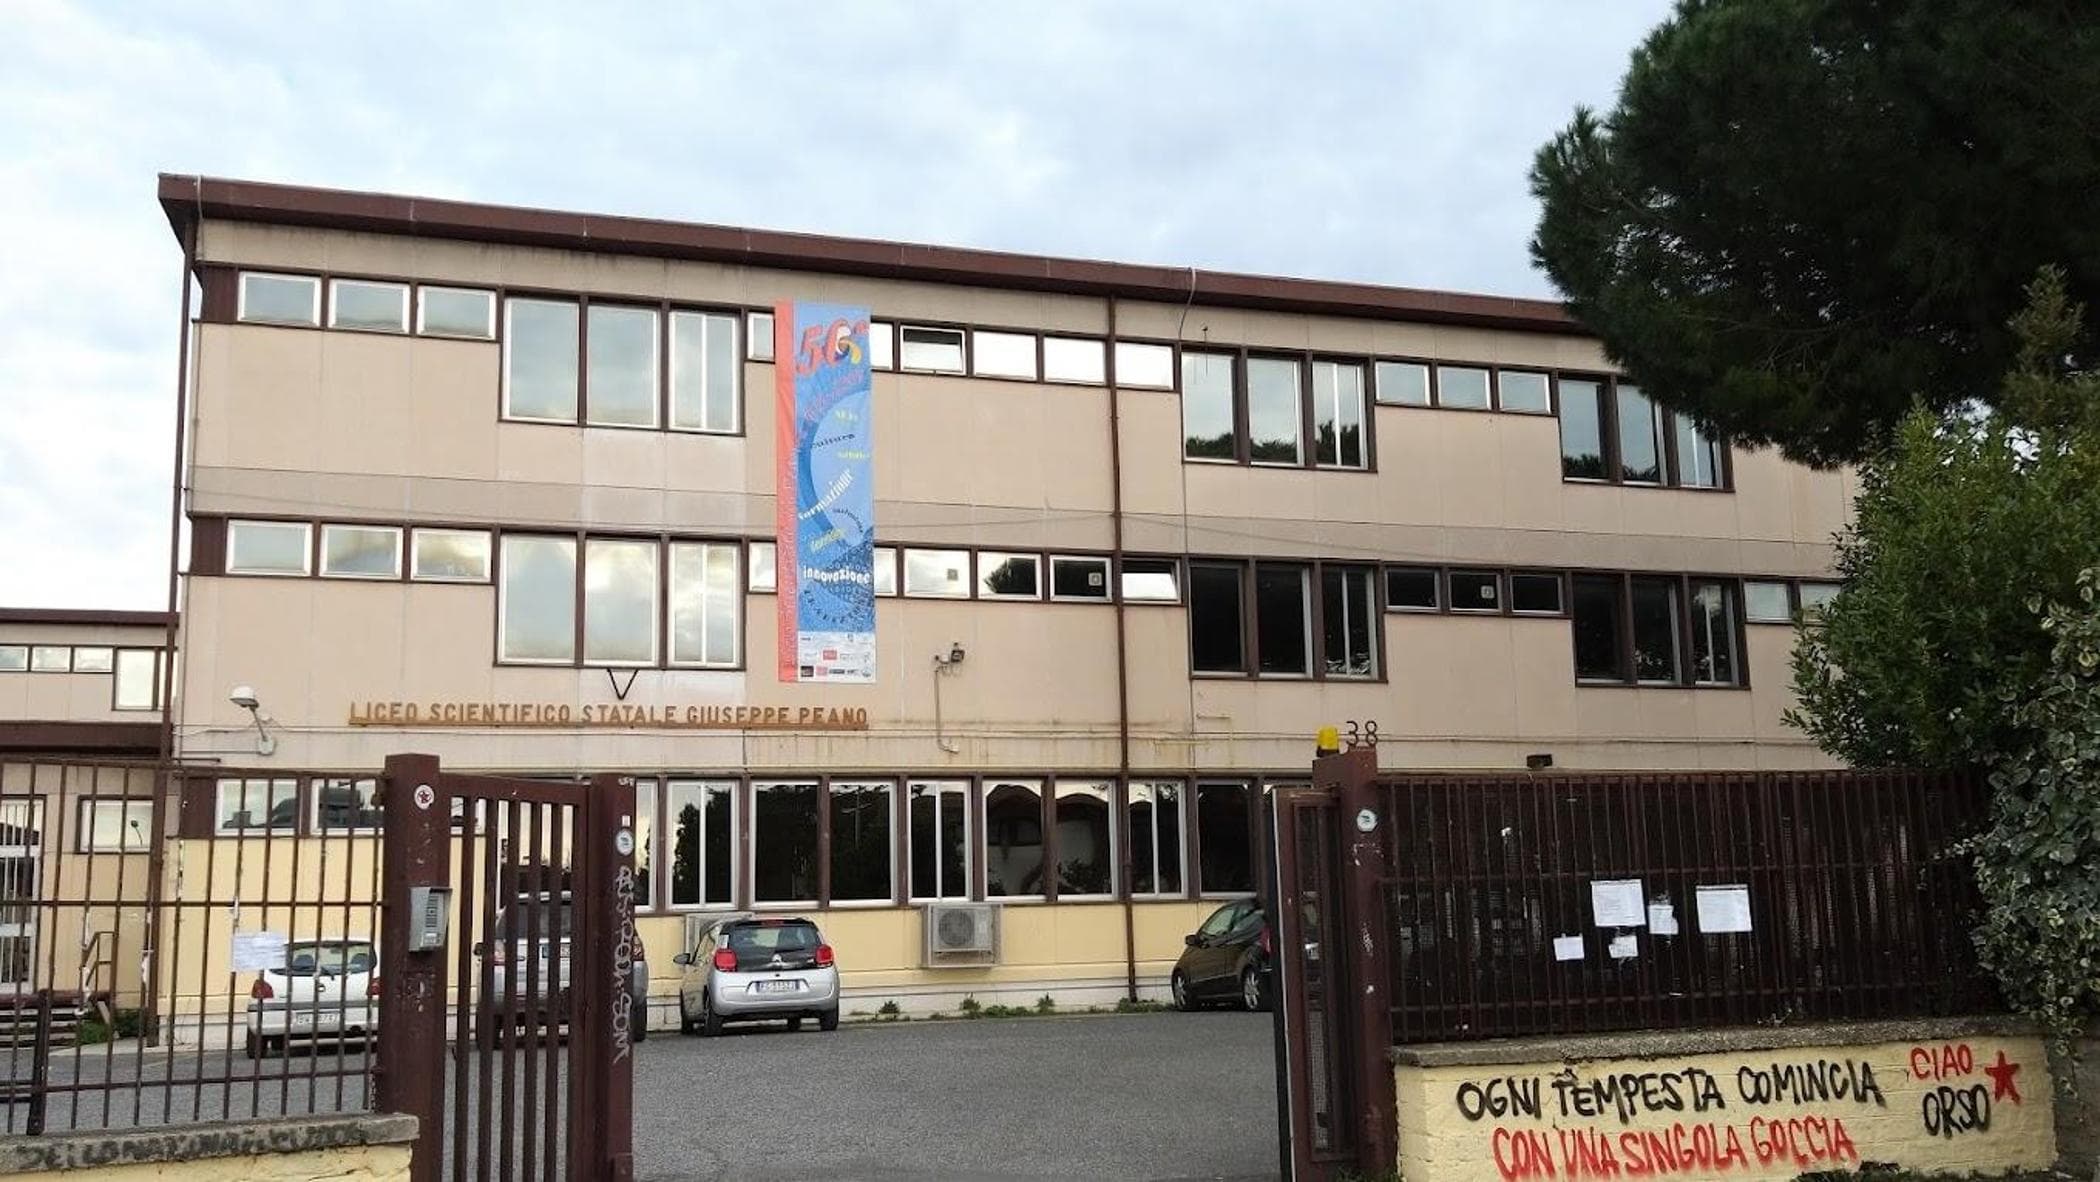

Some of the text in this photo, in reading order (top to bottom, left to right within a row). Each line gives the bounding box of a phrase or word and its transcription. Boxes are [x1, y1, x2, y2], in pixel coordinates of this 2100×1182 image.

[812, 433, 855, 449] cultura
[803, 564, 871, 586] innovazione
[350, 702, 868, 726] LICEO SCIENTIFICO STATALE GIUSEPPE PEANO
[1345, 720, 1378, 746] 38
[1910, 1043, 1974, 1082] CIAO
[1455, 1058, 1887, 1125] OGNI TEMPESTA COMINCIA
[1923, 1083, 1992, 1139] ORSO
[1492, 1126, 1557, 1182] CON
[1750, 1114, 1860, 1169] GOCCIA
